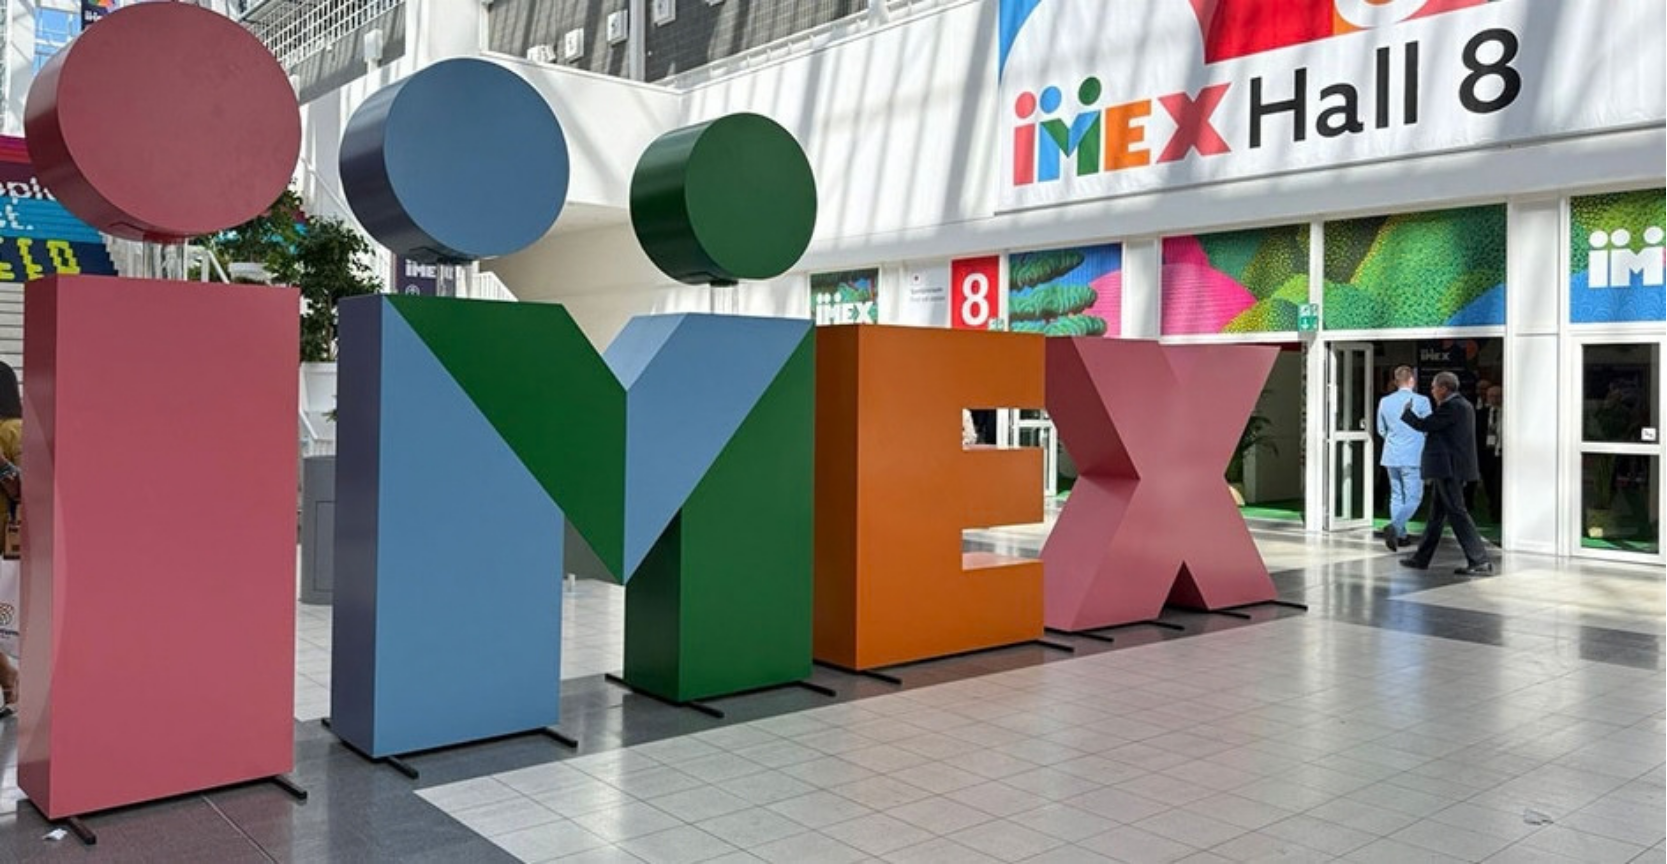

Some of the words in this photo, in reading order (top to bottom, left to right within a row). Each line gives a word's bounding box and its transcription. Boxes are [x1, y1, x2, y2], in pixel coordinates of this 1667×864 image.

[1249, 40, 1419, 149] Hall
[1458, 27, 1522, 114] 8
[962, 272, 990, 326] 8
